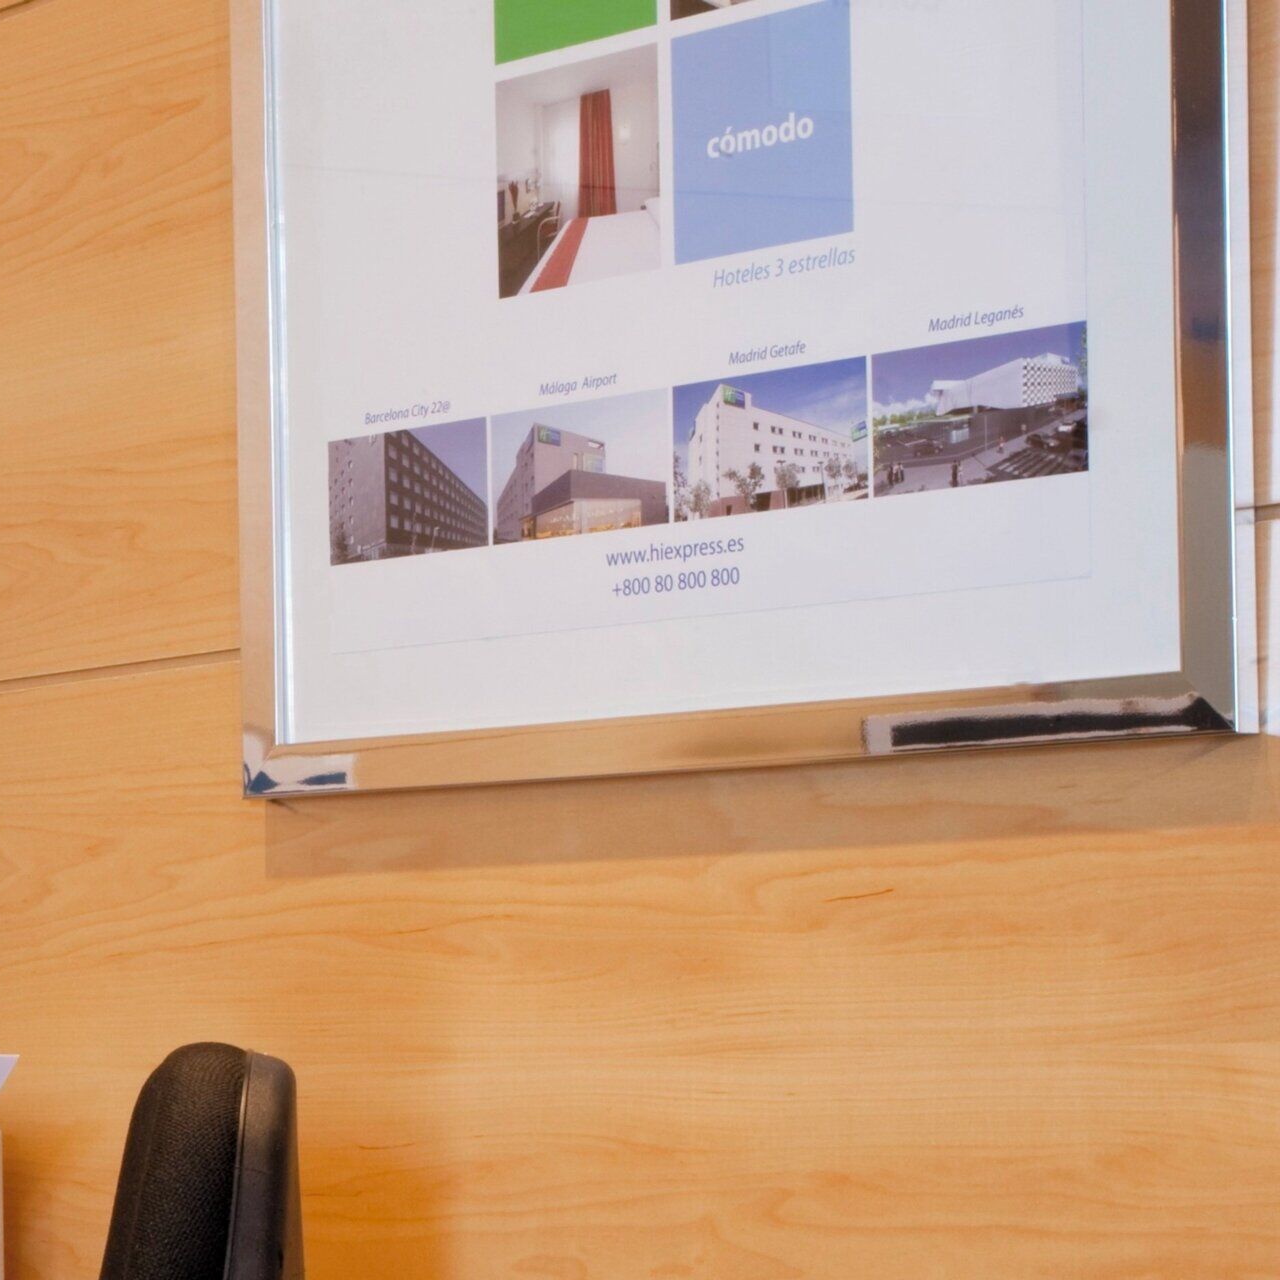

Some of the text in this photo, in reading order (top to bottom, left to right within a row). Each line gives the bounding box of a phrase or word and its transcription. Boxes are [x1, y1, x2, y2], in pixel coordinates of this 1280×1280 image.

[706, 112, 814, 158] cómodo
[713, 247, 856, 288] Hoteles 3 estrellas
[928, 304, 1024, 333] Madrid Leganés
[728, 340, 807, 366] Madrid Getafe
[539, 373, 618, 397] Málaga Airport
[364, 400, 452, 426] Barcelona City 22@
[606, 537, 745, 567] www.hiexpress.es
[612, 566, 741, 597] +800 80 800 800
